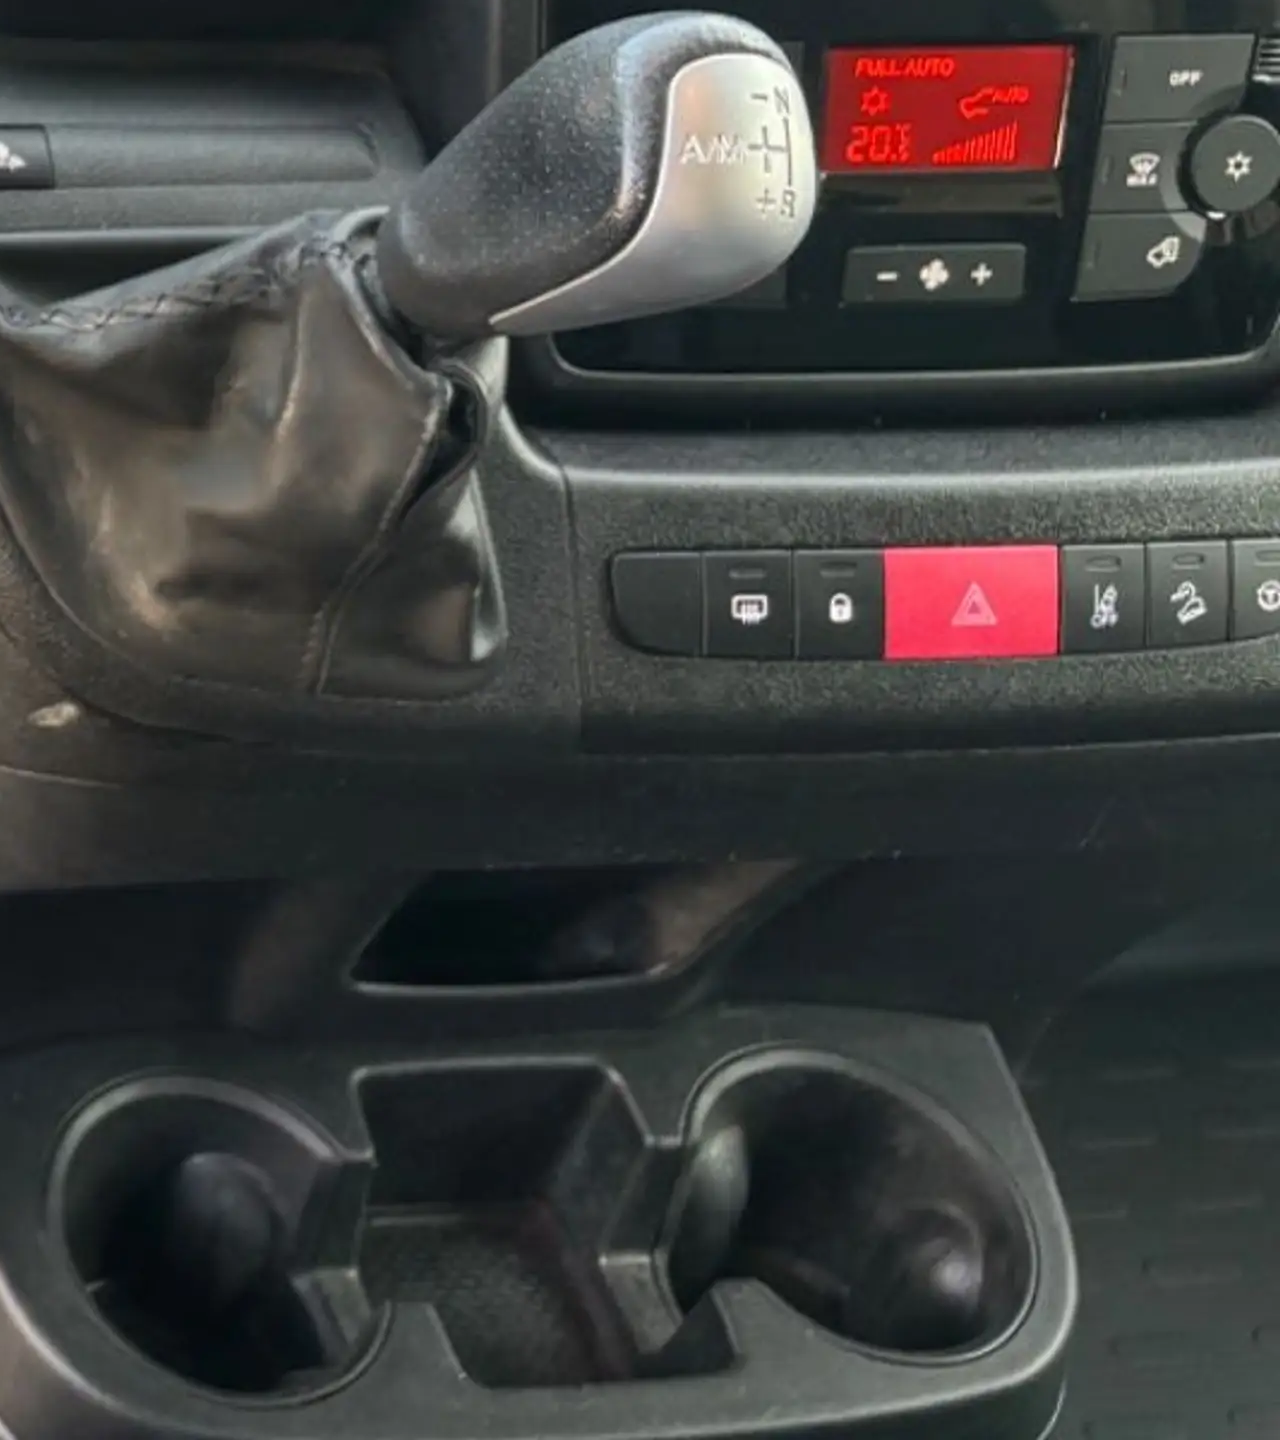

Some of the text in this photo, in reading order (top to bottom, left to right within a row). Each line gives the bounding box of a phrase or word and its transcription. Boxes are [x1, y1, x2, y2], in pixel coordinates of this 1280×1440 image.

[854, 56, 956, 77] FULL AUTO
[1169, 69, 1204, 87] OFF
